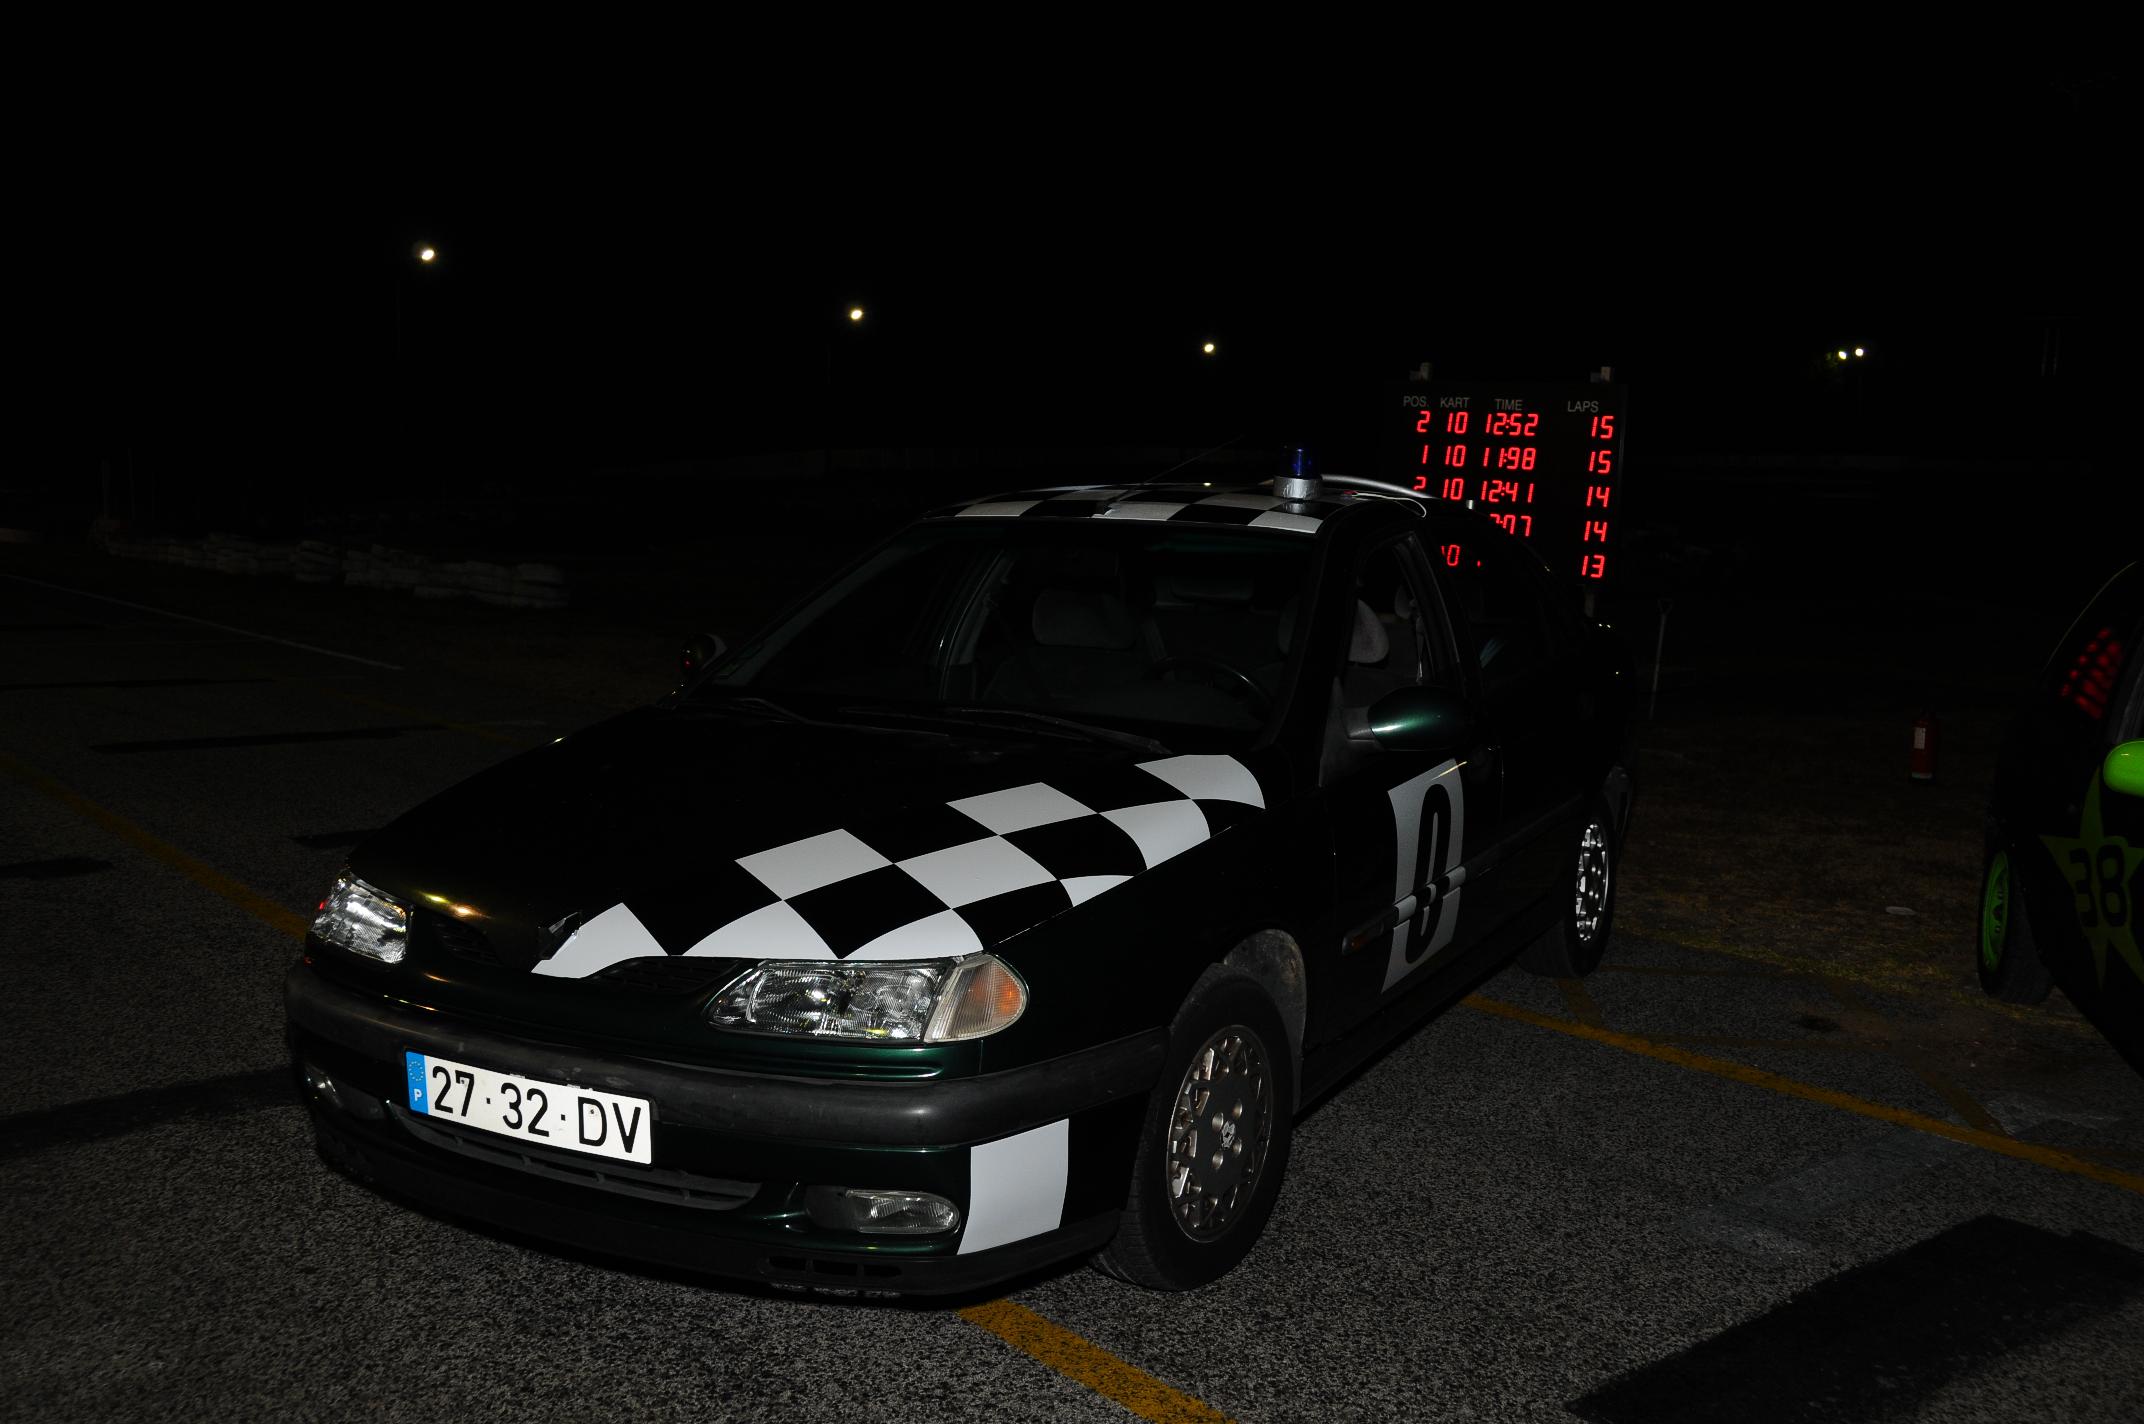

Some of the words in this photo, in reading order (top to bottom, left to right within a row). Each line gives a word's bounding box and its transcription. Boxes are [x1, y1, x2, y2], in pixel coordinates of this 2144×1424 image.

[1403, 396, 1429, 408] POS.
[1440, 397, 1469, 409] KART
[1495, 399, 1522, 411] TIME
[1567, 400, 1599, 413] LAPS
[1417, 411, 1430, 432] 2
[1447, 412, 1468, 434] 10
[1486, 413, 1538, 436] 12:52
[1592, 416, 1614, 439] 15
[1422, 445, 1428, 464] 1
[1445, 445, 1466, 467] 10
[1483, 447, 1536, 470] 11:98
[1589, 450, 1611, 474] 15
[1443, 478, 1464, 500] 10
[1481, 480, 1534, 503] 12:41
[1586, 486, 1610, 507] 14
[1584, 521, 1607, 542] 14
[1582, 555, 1605, 578] 13
[413, 1088, 422, 1101] P
